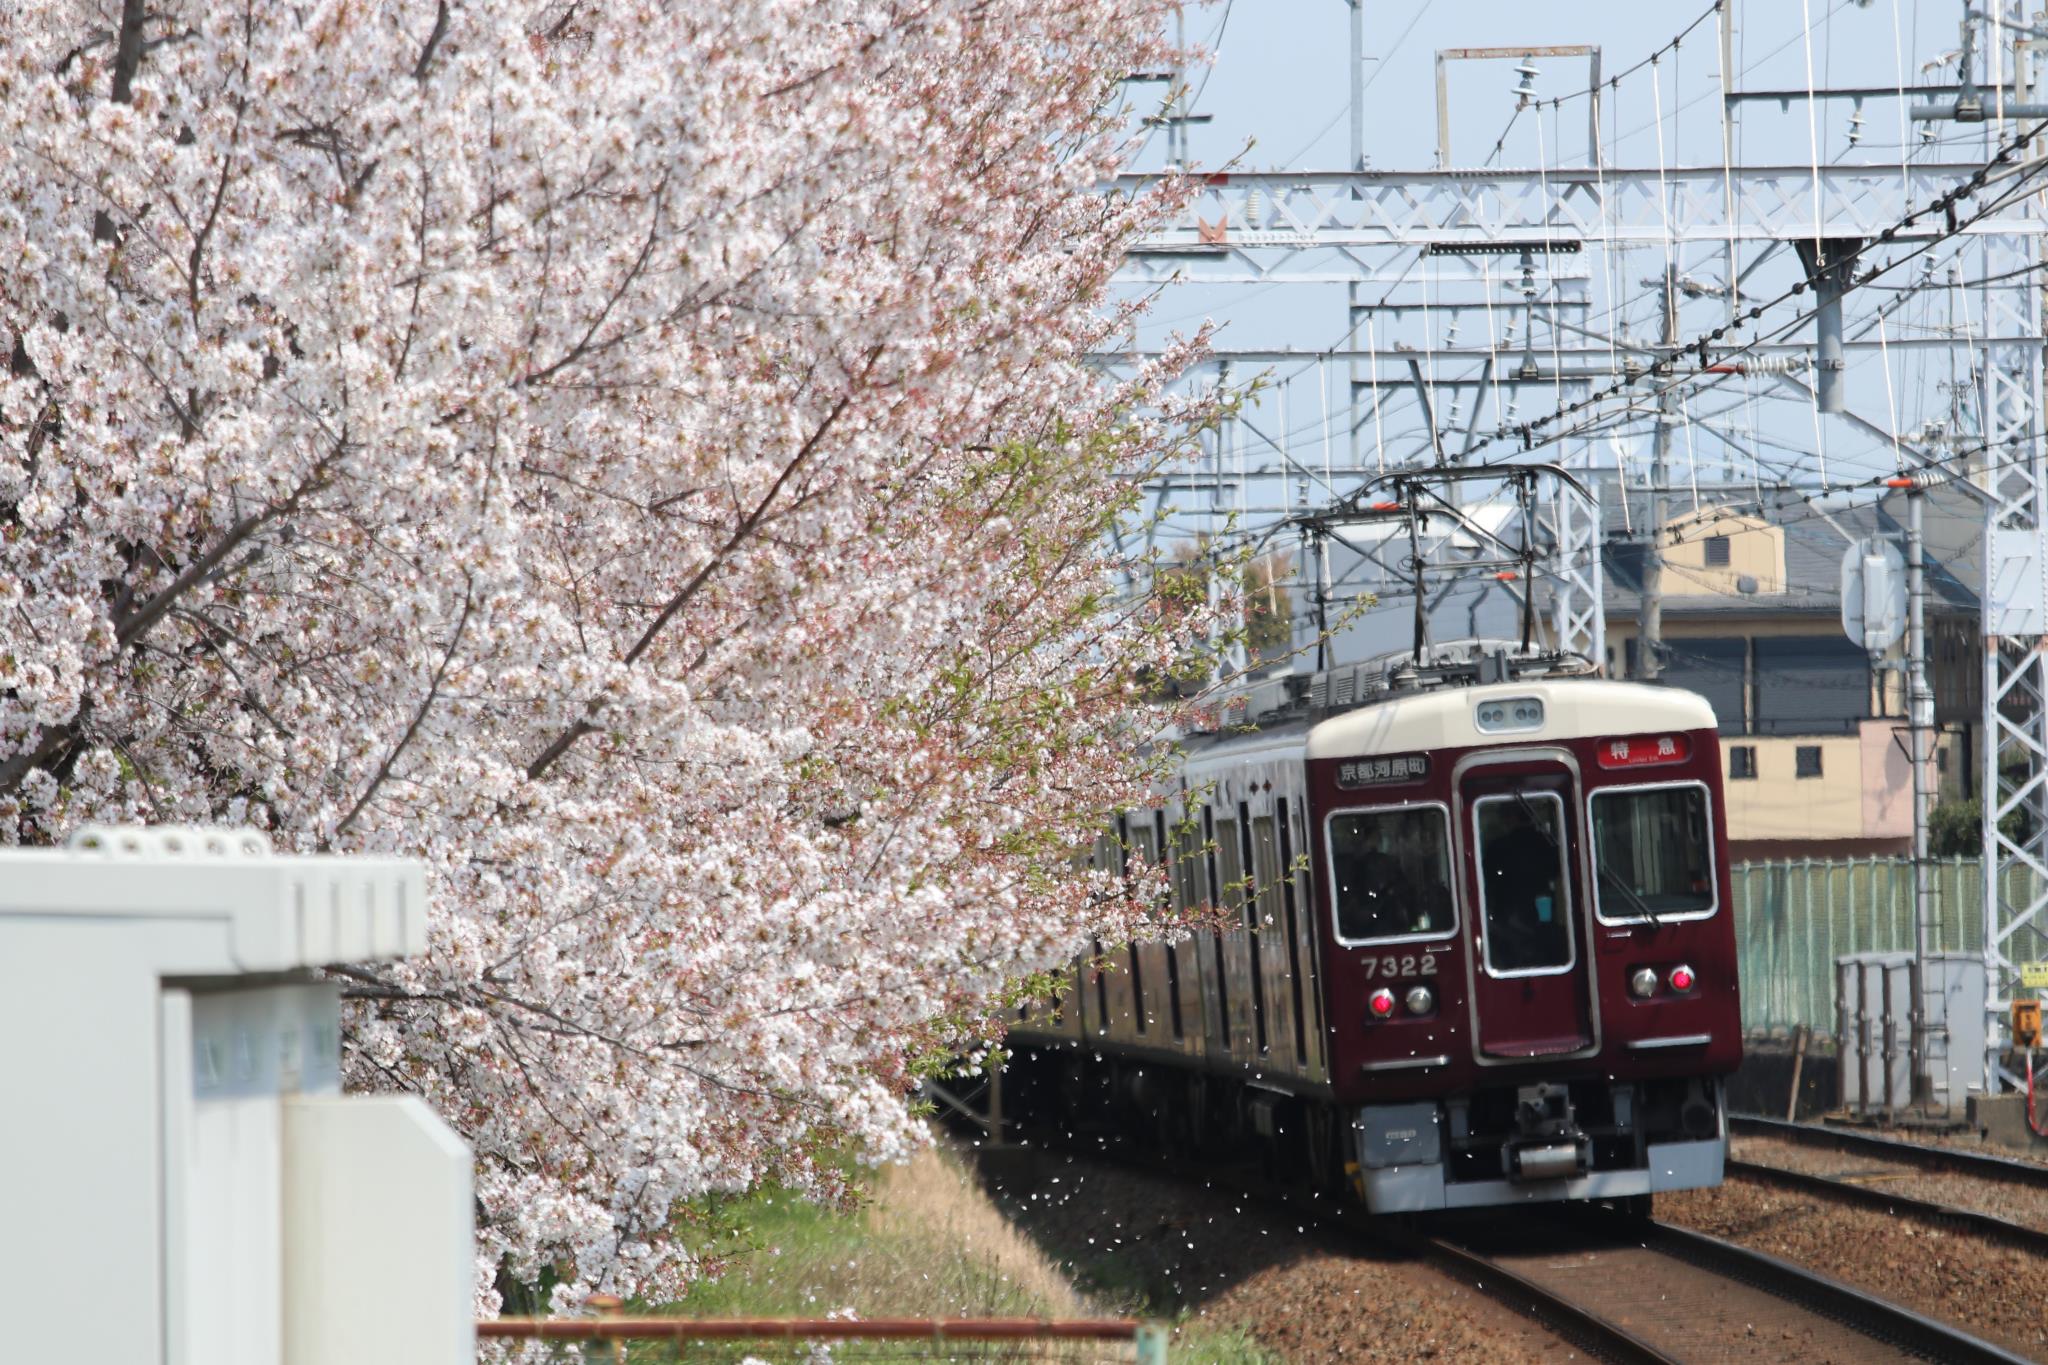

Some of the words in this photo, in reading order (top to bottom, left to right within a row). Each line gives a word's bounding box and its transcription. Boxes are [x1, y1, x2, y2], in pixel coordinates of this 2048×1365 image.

[1340, 758, 1426, 781] 京都河原町
[1361, 955, 1438, 979] 7322
